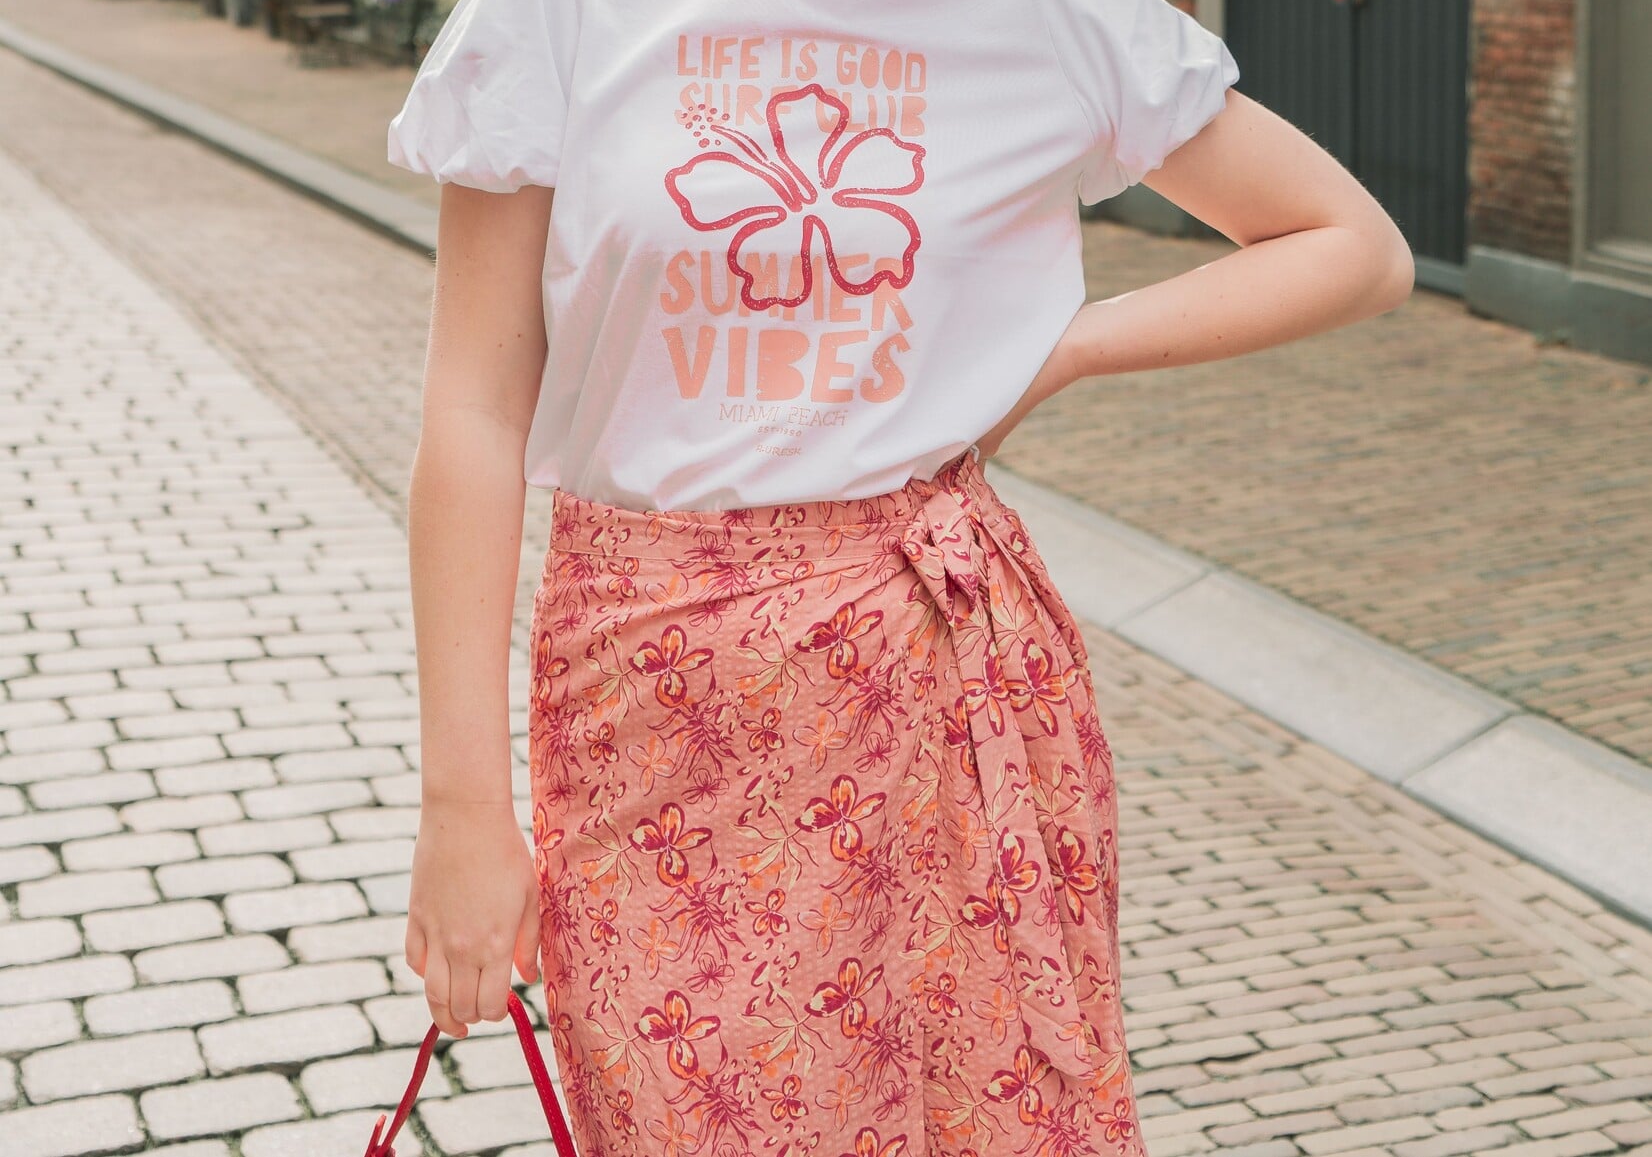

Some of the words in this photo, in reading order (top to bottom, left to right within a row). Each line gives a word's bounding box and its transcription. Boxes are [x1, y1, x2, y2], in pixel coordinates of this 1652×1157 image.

[677, 35, 764, 79] LIFE
[781, 39, 818, 81] IS
[836, 44, 927, 93] GOOD
[814, 88, 928, 137] CLUB
[660, 250, 914, 331] SUMMER
[662, 325, 911, 403] VIBES
[719, 403, 779, 423] MIAMI
